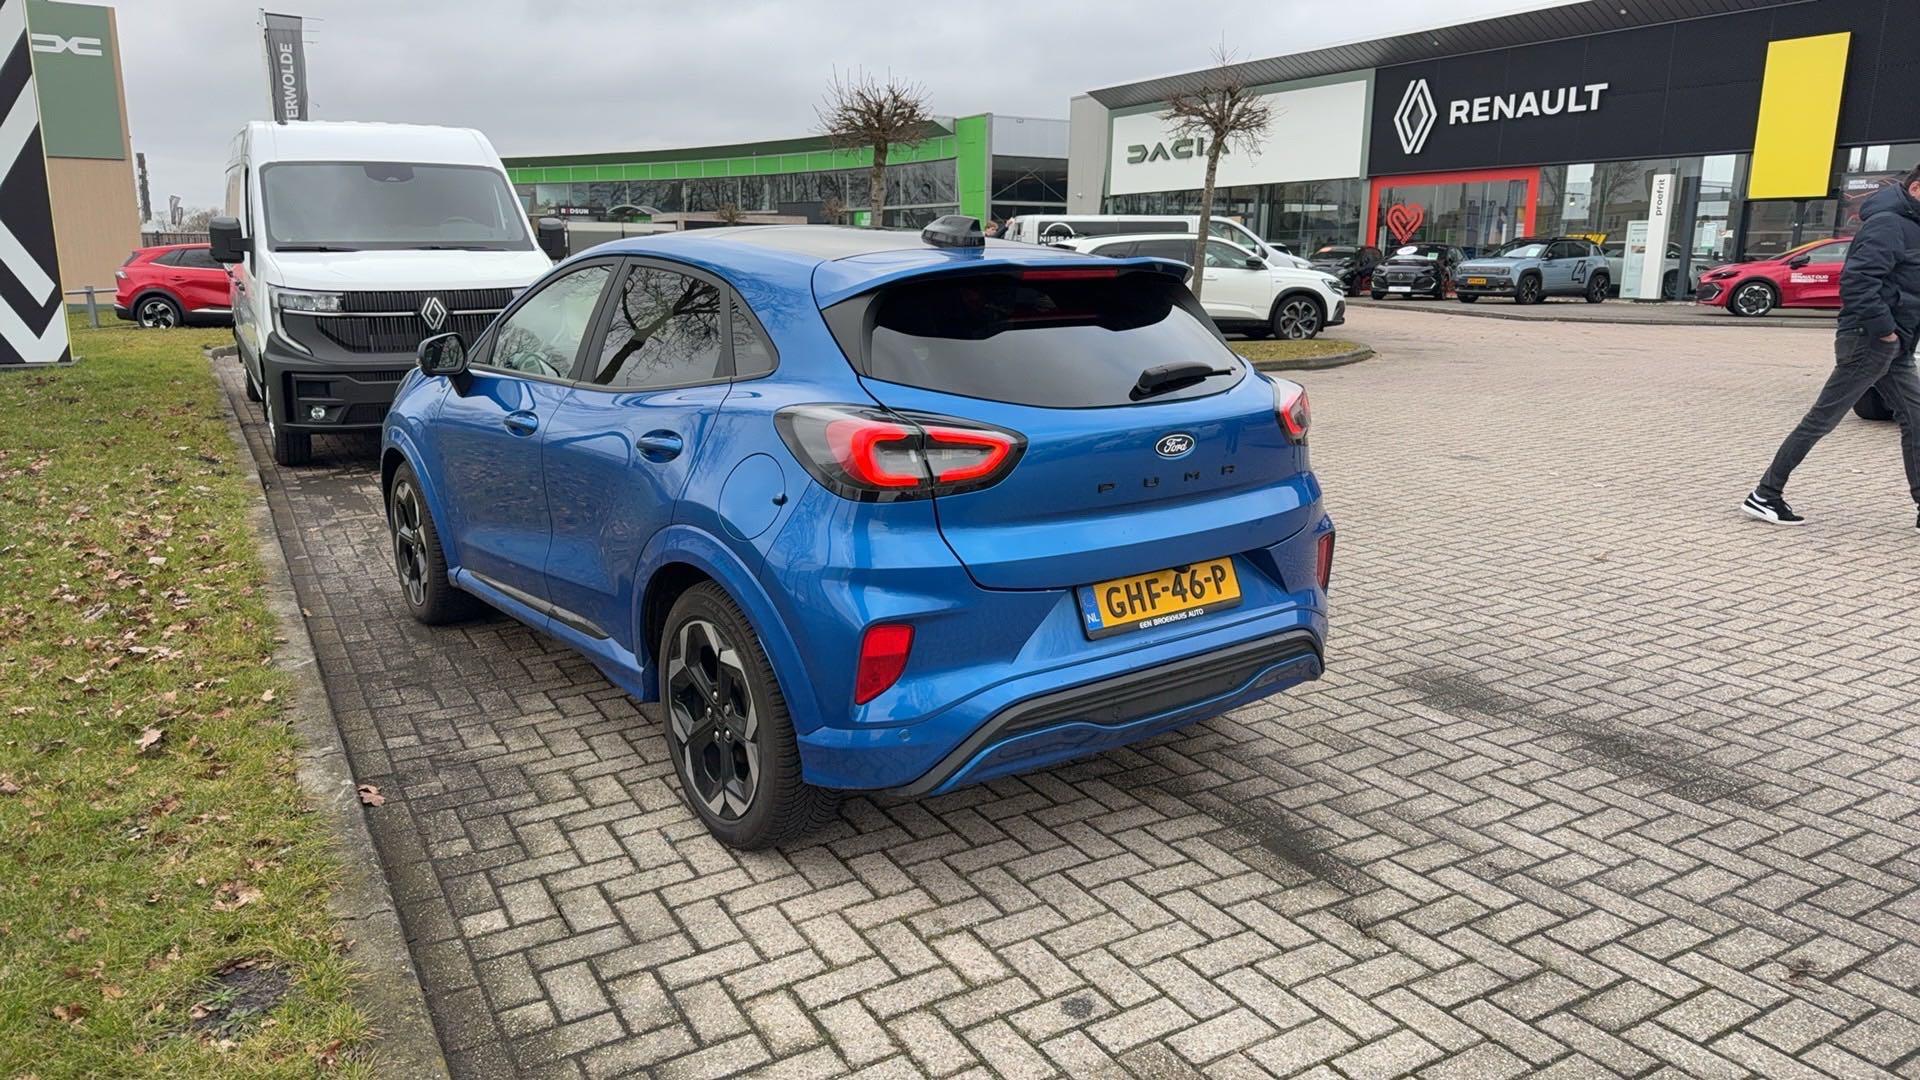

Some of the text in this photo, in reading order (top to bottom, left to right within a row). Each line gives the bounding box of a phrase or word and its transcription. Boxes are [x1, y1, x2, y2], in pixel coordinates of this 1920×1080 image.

[1449, 82, 1609, 125] RENAULT
[1656, 178, 1666, 216] proefrit
[1164, 438, 1188, 453] Ford
[1106, 564, 1227, 618] GHF-46-P
[1087, 612, 1101, 624] NL
[1139, 608, 1205, 629] EEN BROEKHUIS AUTO
